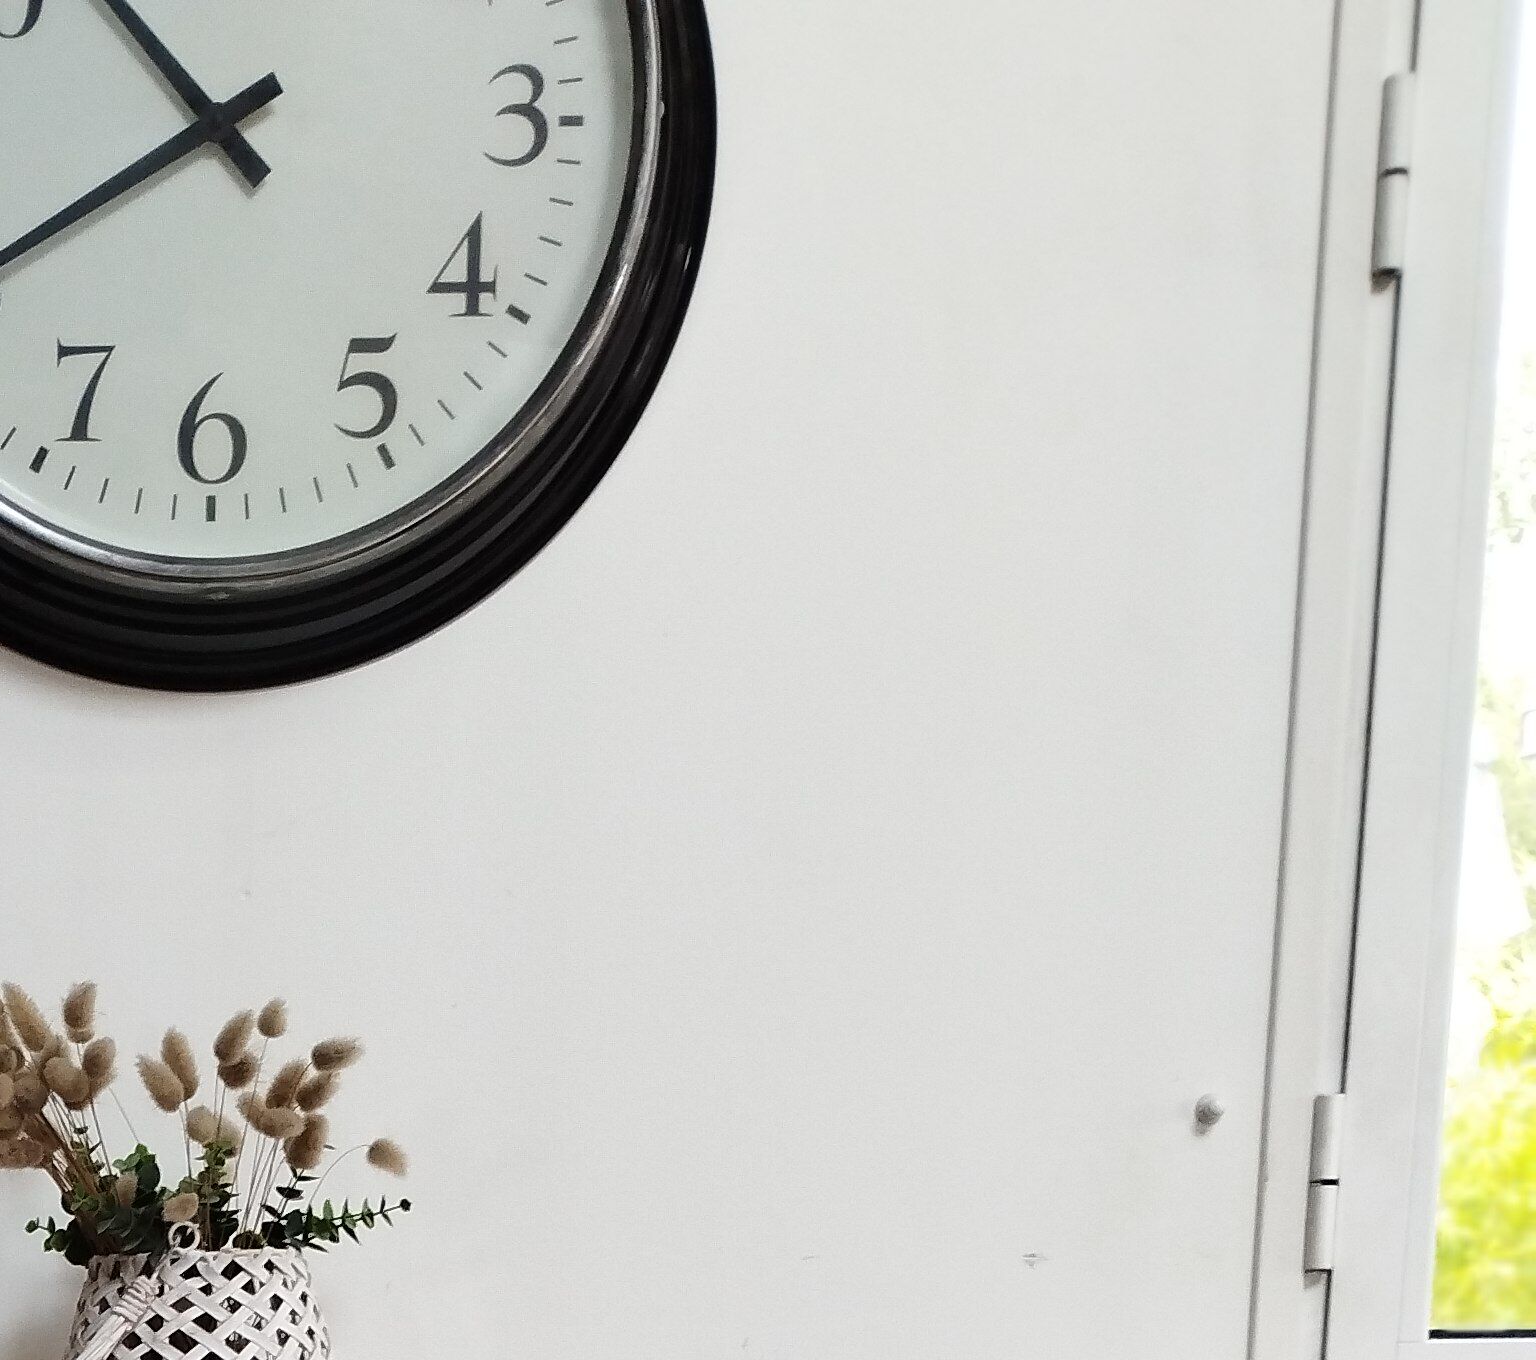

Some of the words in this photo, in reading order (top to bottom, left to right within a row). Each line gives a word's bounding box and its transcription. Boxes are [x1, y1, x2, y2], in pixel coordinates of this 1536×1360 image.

[482, 63, 549, 168] 3
[425, 210, 498, 318] 4
[54, 338, 116, 443] 7
[176, 371, 248, 485] 6
[334, 332, 398, 440] 5
